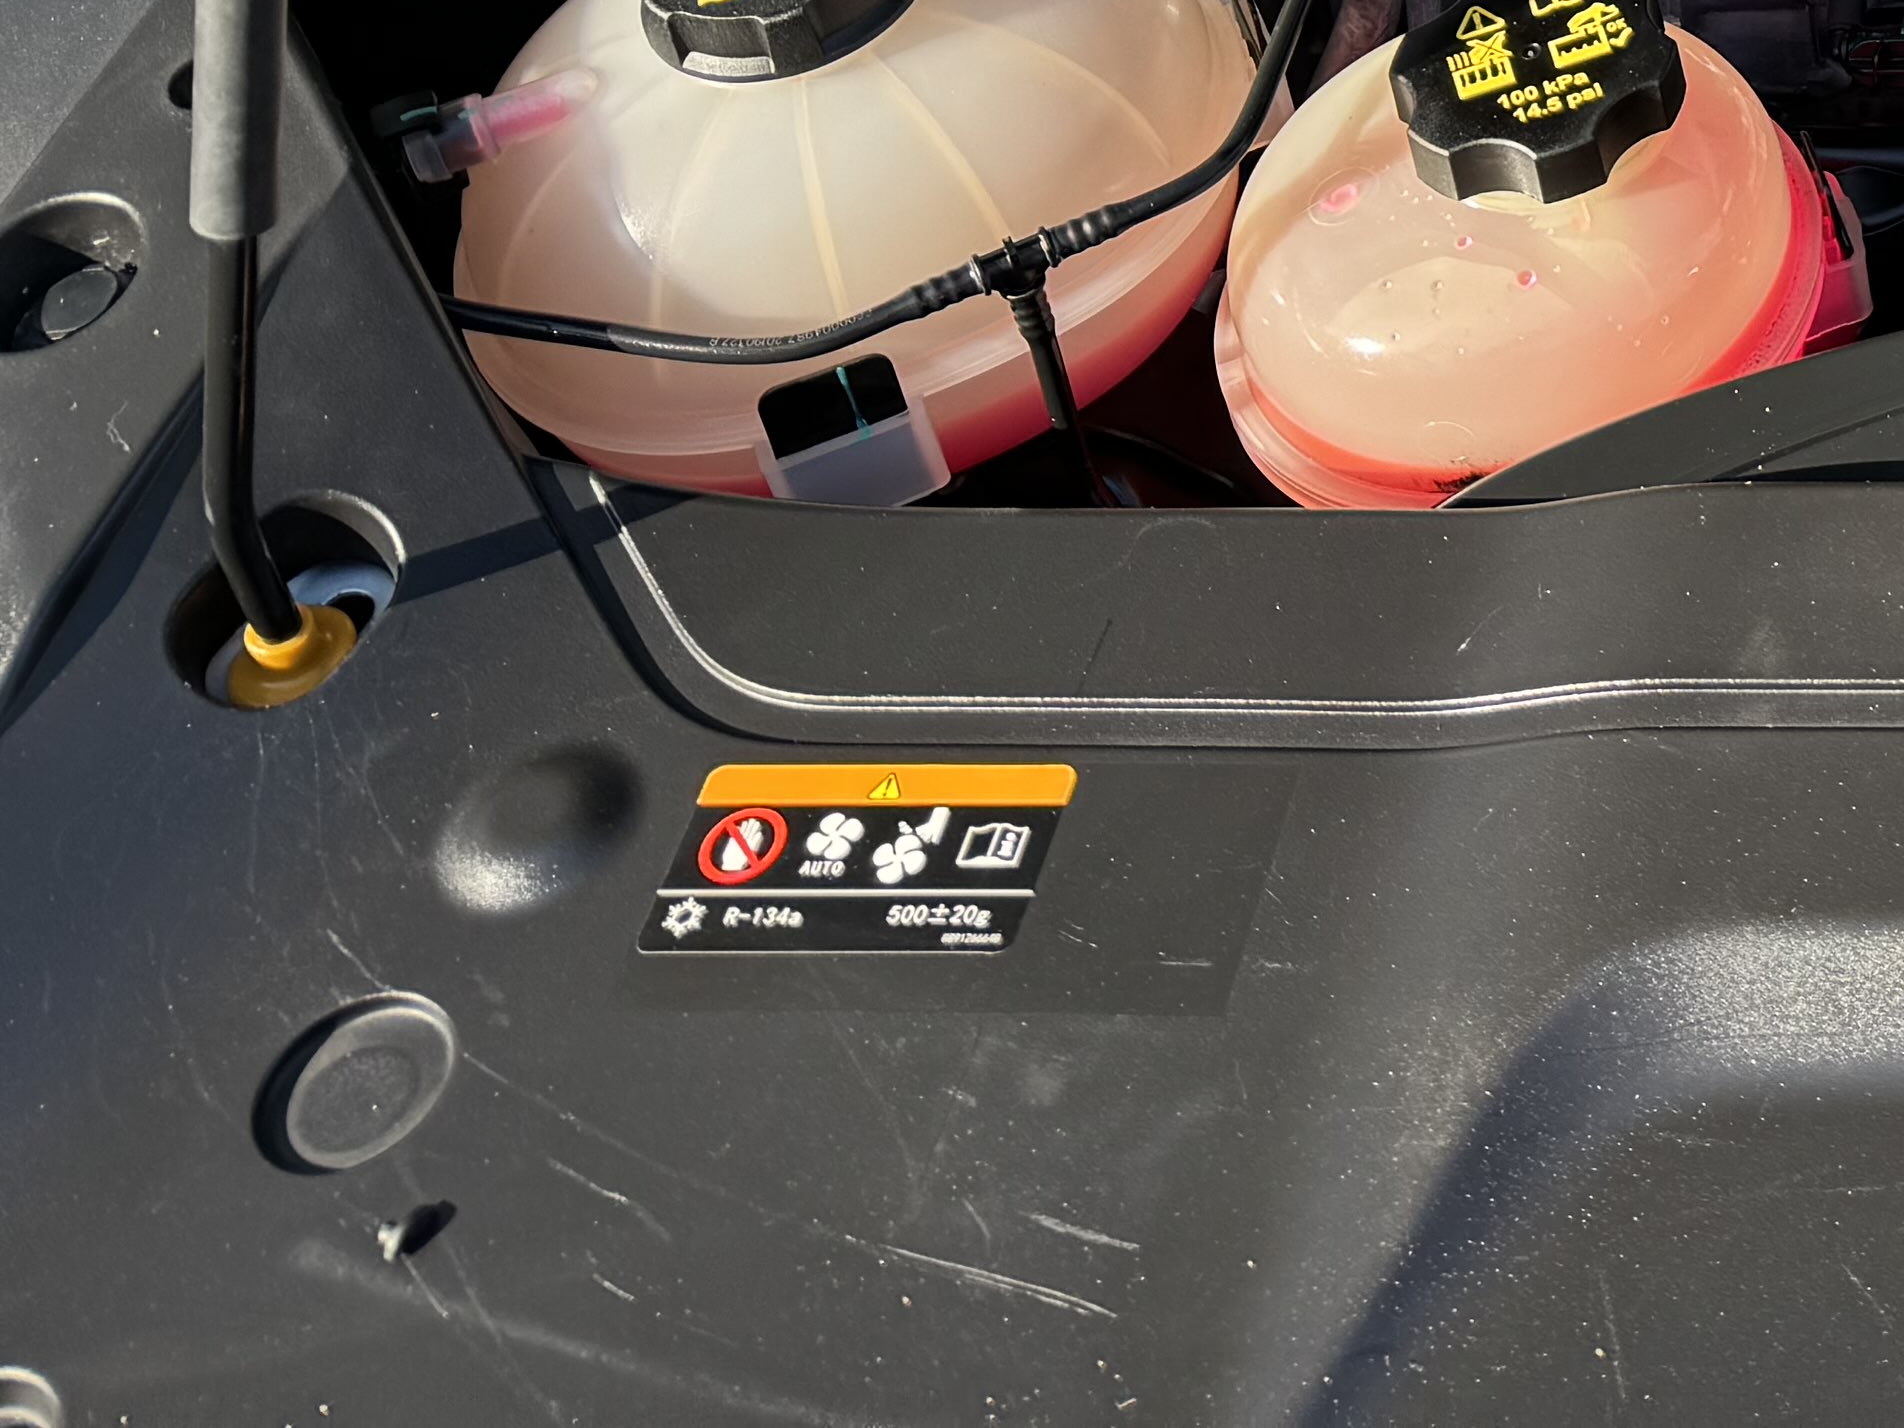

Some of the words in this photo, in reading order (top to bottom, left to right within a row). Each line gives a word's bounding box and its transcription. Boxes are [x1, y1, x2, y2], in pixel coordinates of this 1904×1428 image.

[1606, 19, 1627, 33] OK
[1497, 84, 1540, 112] 100
[1543, 70, 1591, 97] kPa
[1513, 97, 1563, 125] 14.5
[1567, 83, 1606, 112] psi
[798, 859, 846, 878] AUTO
[722, 905, 804, 928] R-134a
[886, 904, 992, 929] 500±20g
